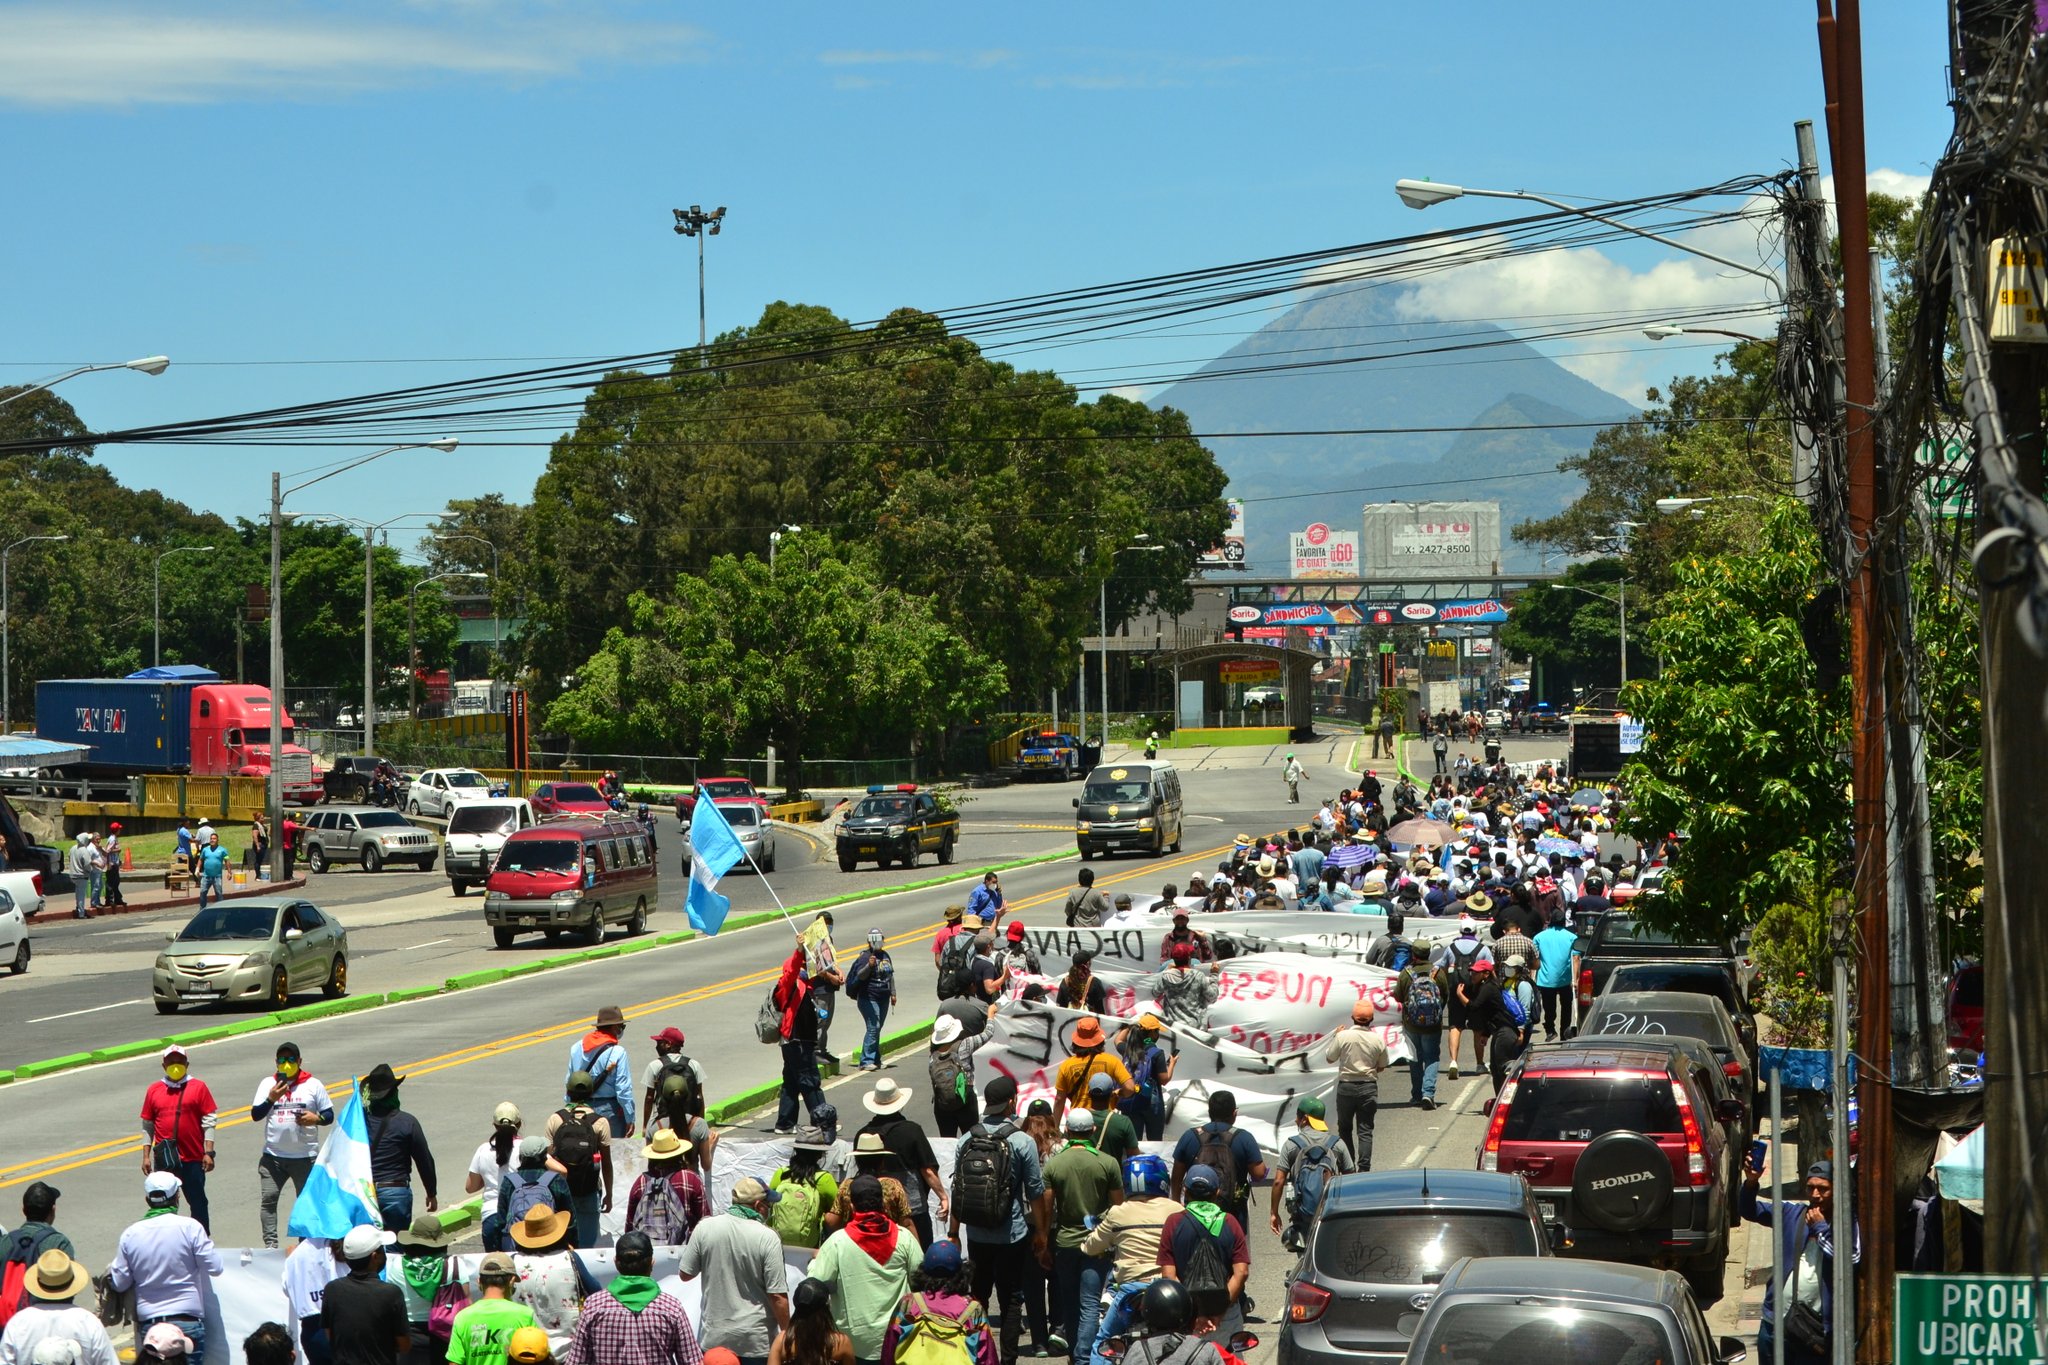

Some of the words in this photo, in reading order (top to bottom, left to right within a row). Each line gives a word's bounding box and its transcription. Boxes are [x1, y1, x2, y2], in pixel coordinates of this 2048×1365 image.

[1296, 538, 1305, 547] LA
[1296, 548, 1326, 557] FAVORITA
[1420, 545, 1470, 554] 2427-8500
[1297, 559, 1305, 568] DE
[1306, 558, 1327, 568] GUATE
[1231, 609, 1256, 618] Sarita
[1406, 606, 1431, 615] Sarita
[1591, 1171, 1655, 1190] HONDA
[310, 1289, 325, 1302] US
[1918, 1321, 2024, 1357] UBICAR
